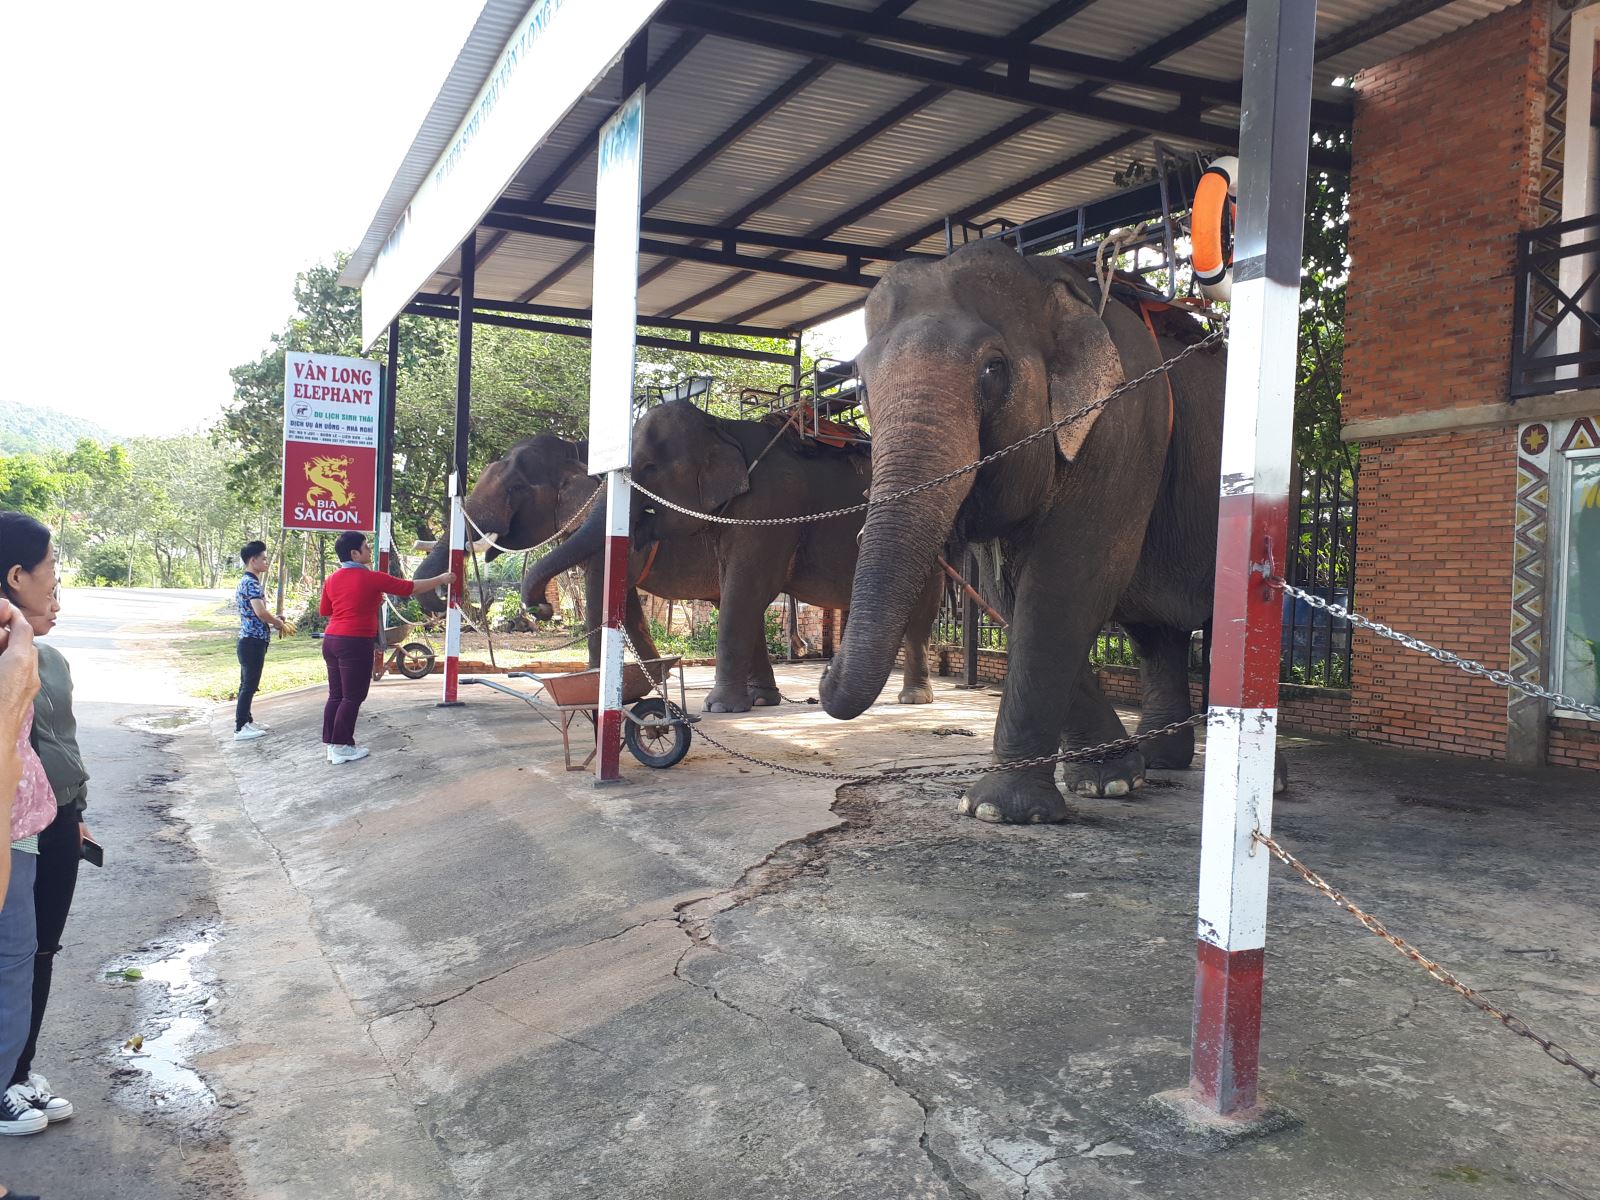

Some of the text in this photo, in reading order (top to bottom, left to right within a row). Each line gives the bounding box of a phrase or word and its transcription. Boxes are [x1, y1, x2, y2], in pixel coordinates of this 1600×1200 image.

[293, 359, 372, 386] VÂN LONG
[293, 383, 373, 405] ELEPHANT
[314, 411, 324, 419] DU
[341, 413, 357, 422] SINH
[316, 499, 337, 510] BIA
[294, 506, 359, 524] SAIGON
